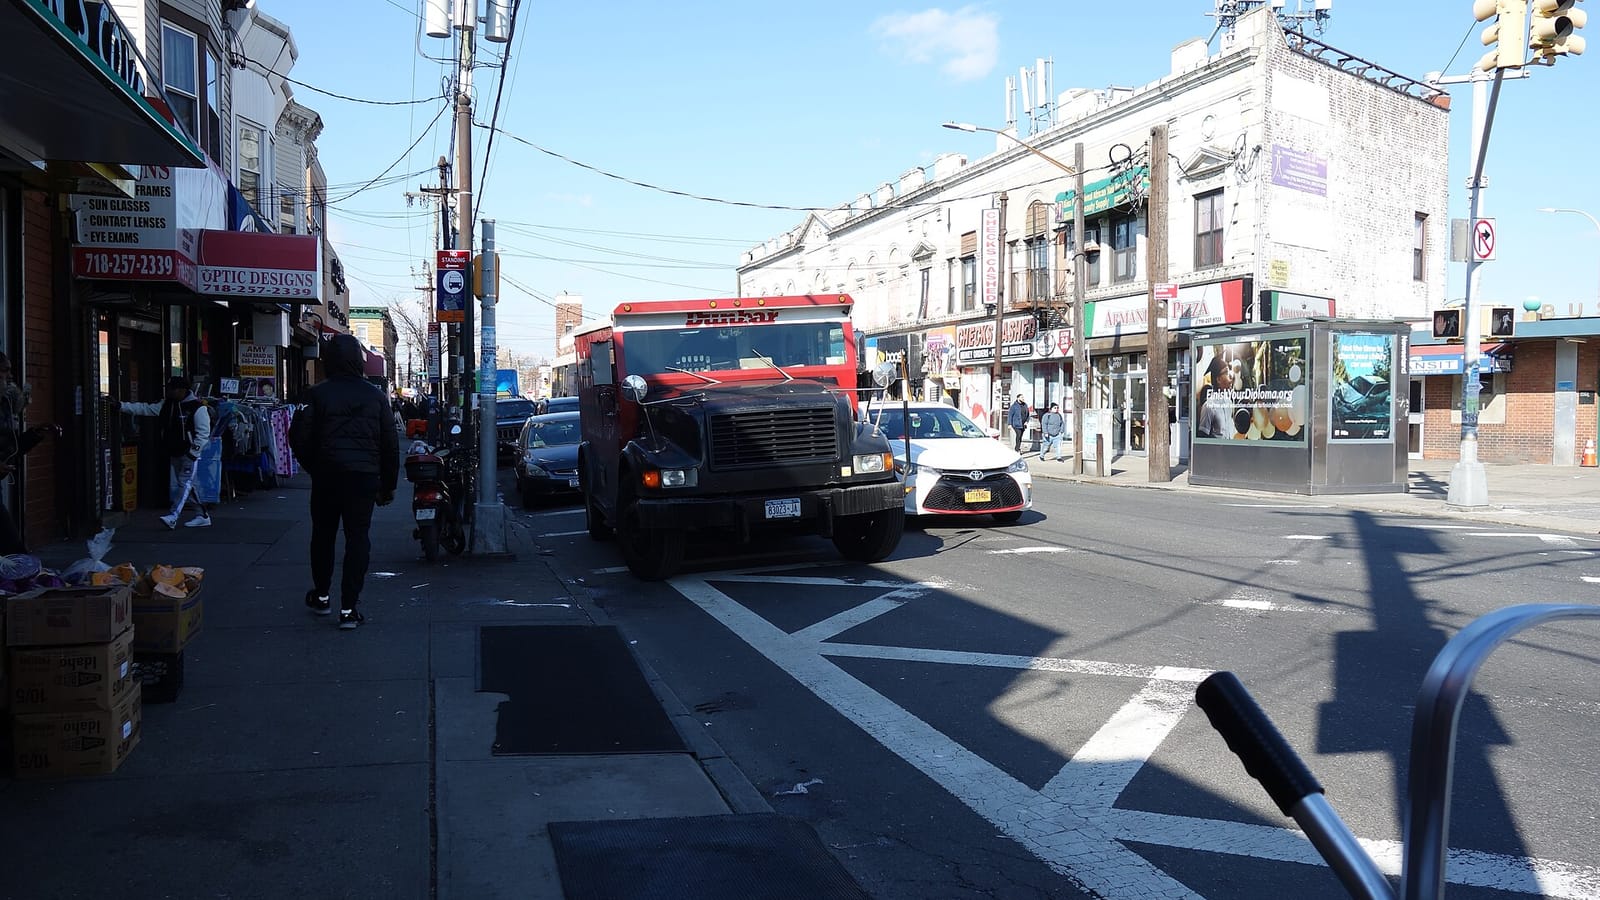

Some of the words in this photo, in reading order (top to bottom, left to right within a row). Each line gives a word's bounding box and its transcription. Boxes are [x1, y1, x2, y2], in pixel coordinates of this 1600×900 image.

[135, 185, 171, 198] FRAMES
[89, 199, 108, 211] SUN
[110, 200, 150, 212] GLASSES
[90, 215, 132, 228] CONTACT
[134, 216, 166, 229] LENSES
[90, 232, 106, 243] EYE
[108, 232, 139, 244] EXAMS
[986, 211, 997, 256] CHECKS
[85, 253, 174, 275] 718-257-2339
[201, 269, 246, 284] OPTIC
[250, 271, 313, 287] DESIGNS
[986, 258, 997, 302] CASHED
[203, 284, 312, 296] 718-257-2339
[1172, 301, 1209, 320] PIZZA
[686, 310, 779, 327] Dunbar
[958, 324, 994, 349] CHECKS
[1002, 318, 1037, 344] ASHED
[1207, 387, 1294, 402] FinishYourDiploma.org
[60, 656, 97, 670] Idaho
[64, 720, 100, 735] Idaho
